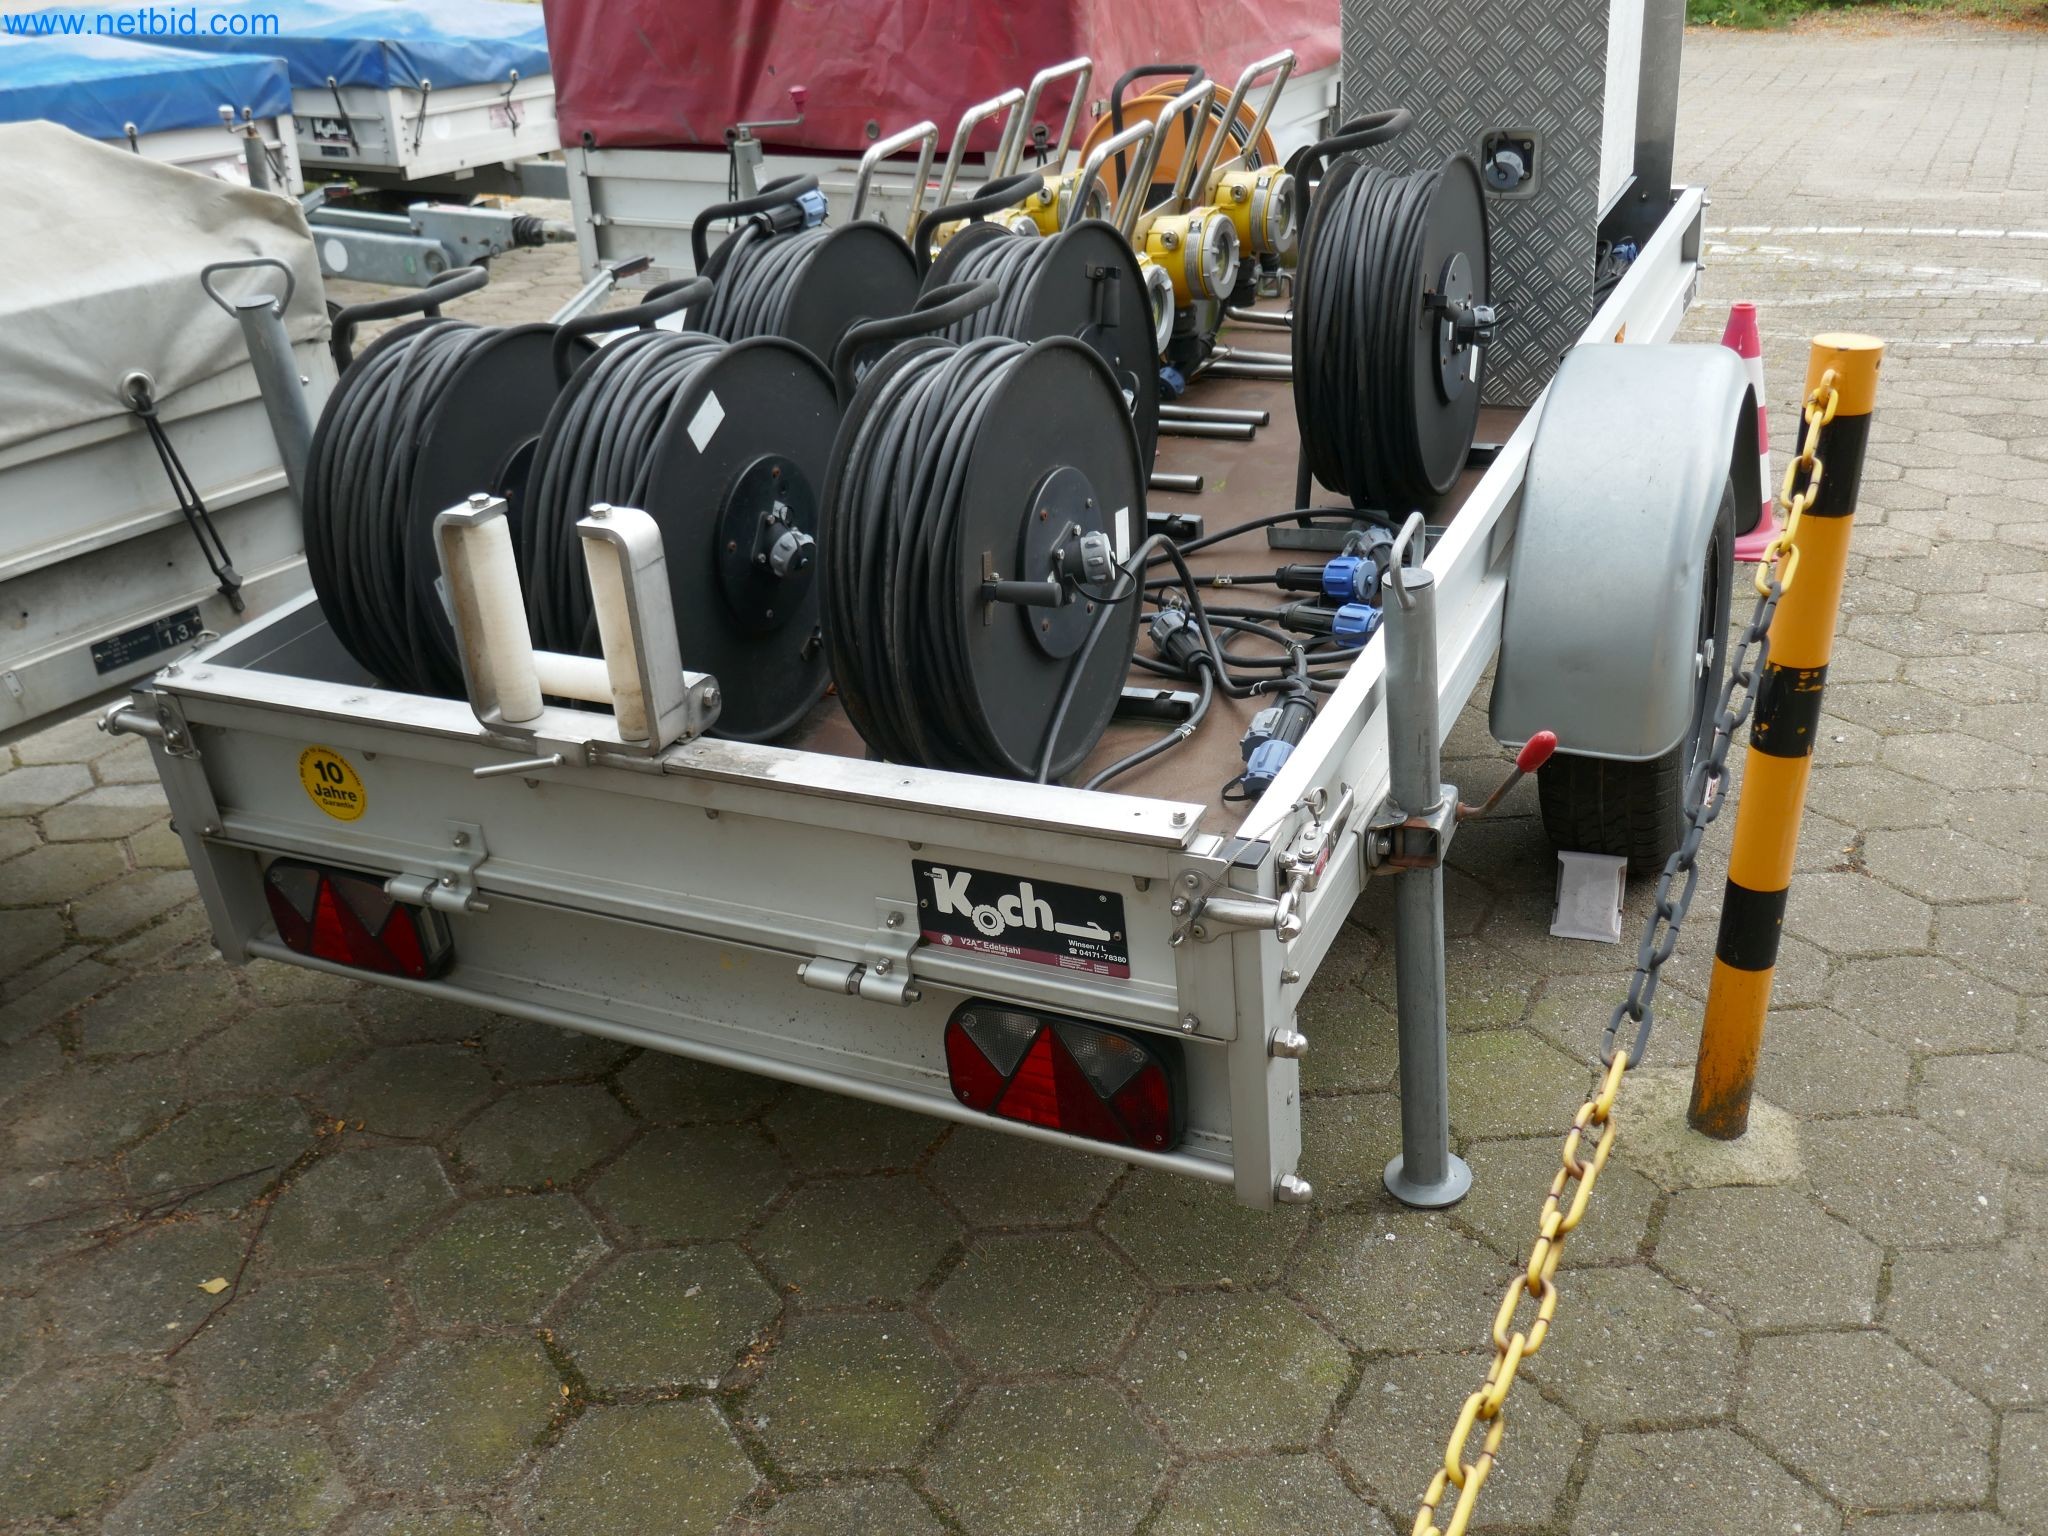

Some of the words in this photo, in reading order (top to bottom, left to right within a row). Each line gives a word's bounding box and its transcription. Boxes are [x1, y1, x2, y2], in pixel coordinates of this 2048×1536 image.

[314, 760, 344, 784] 10
[314, 784, 357, 802] Jahre
[322, 799, 355, 810] Garantie
[983, 941, 1021, 955] Edelstahl
[1068, 939, 1095, 951] Winsen
